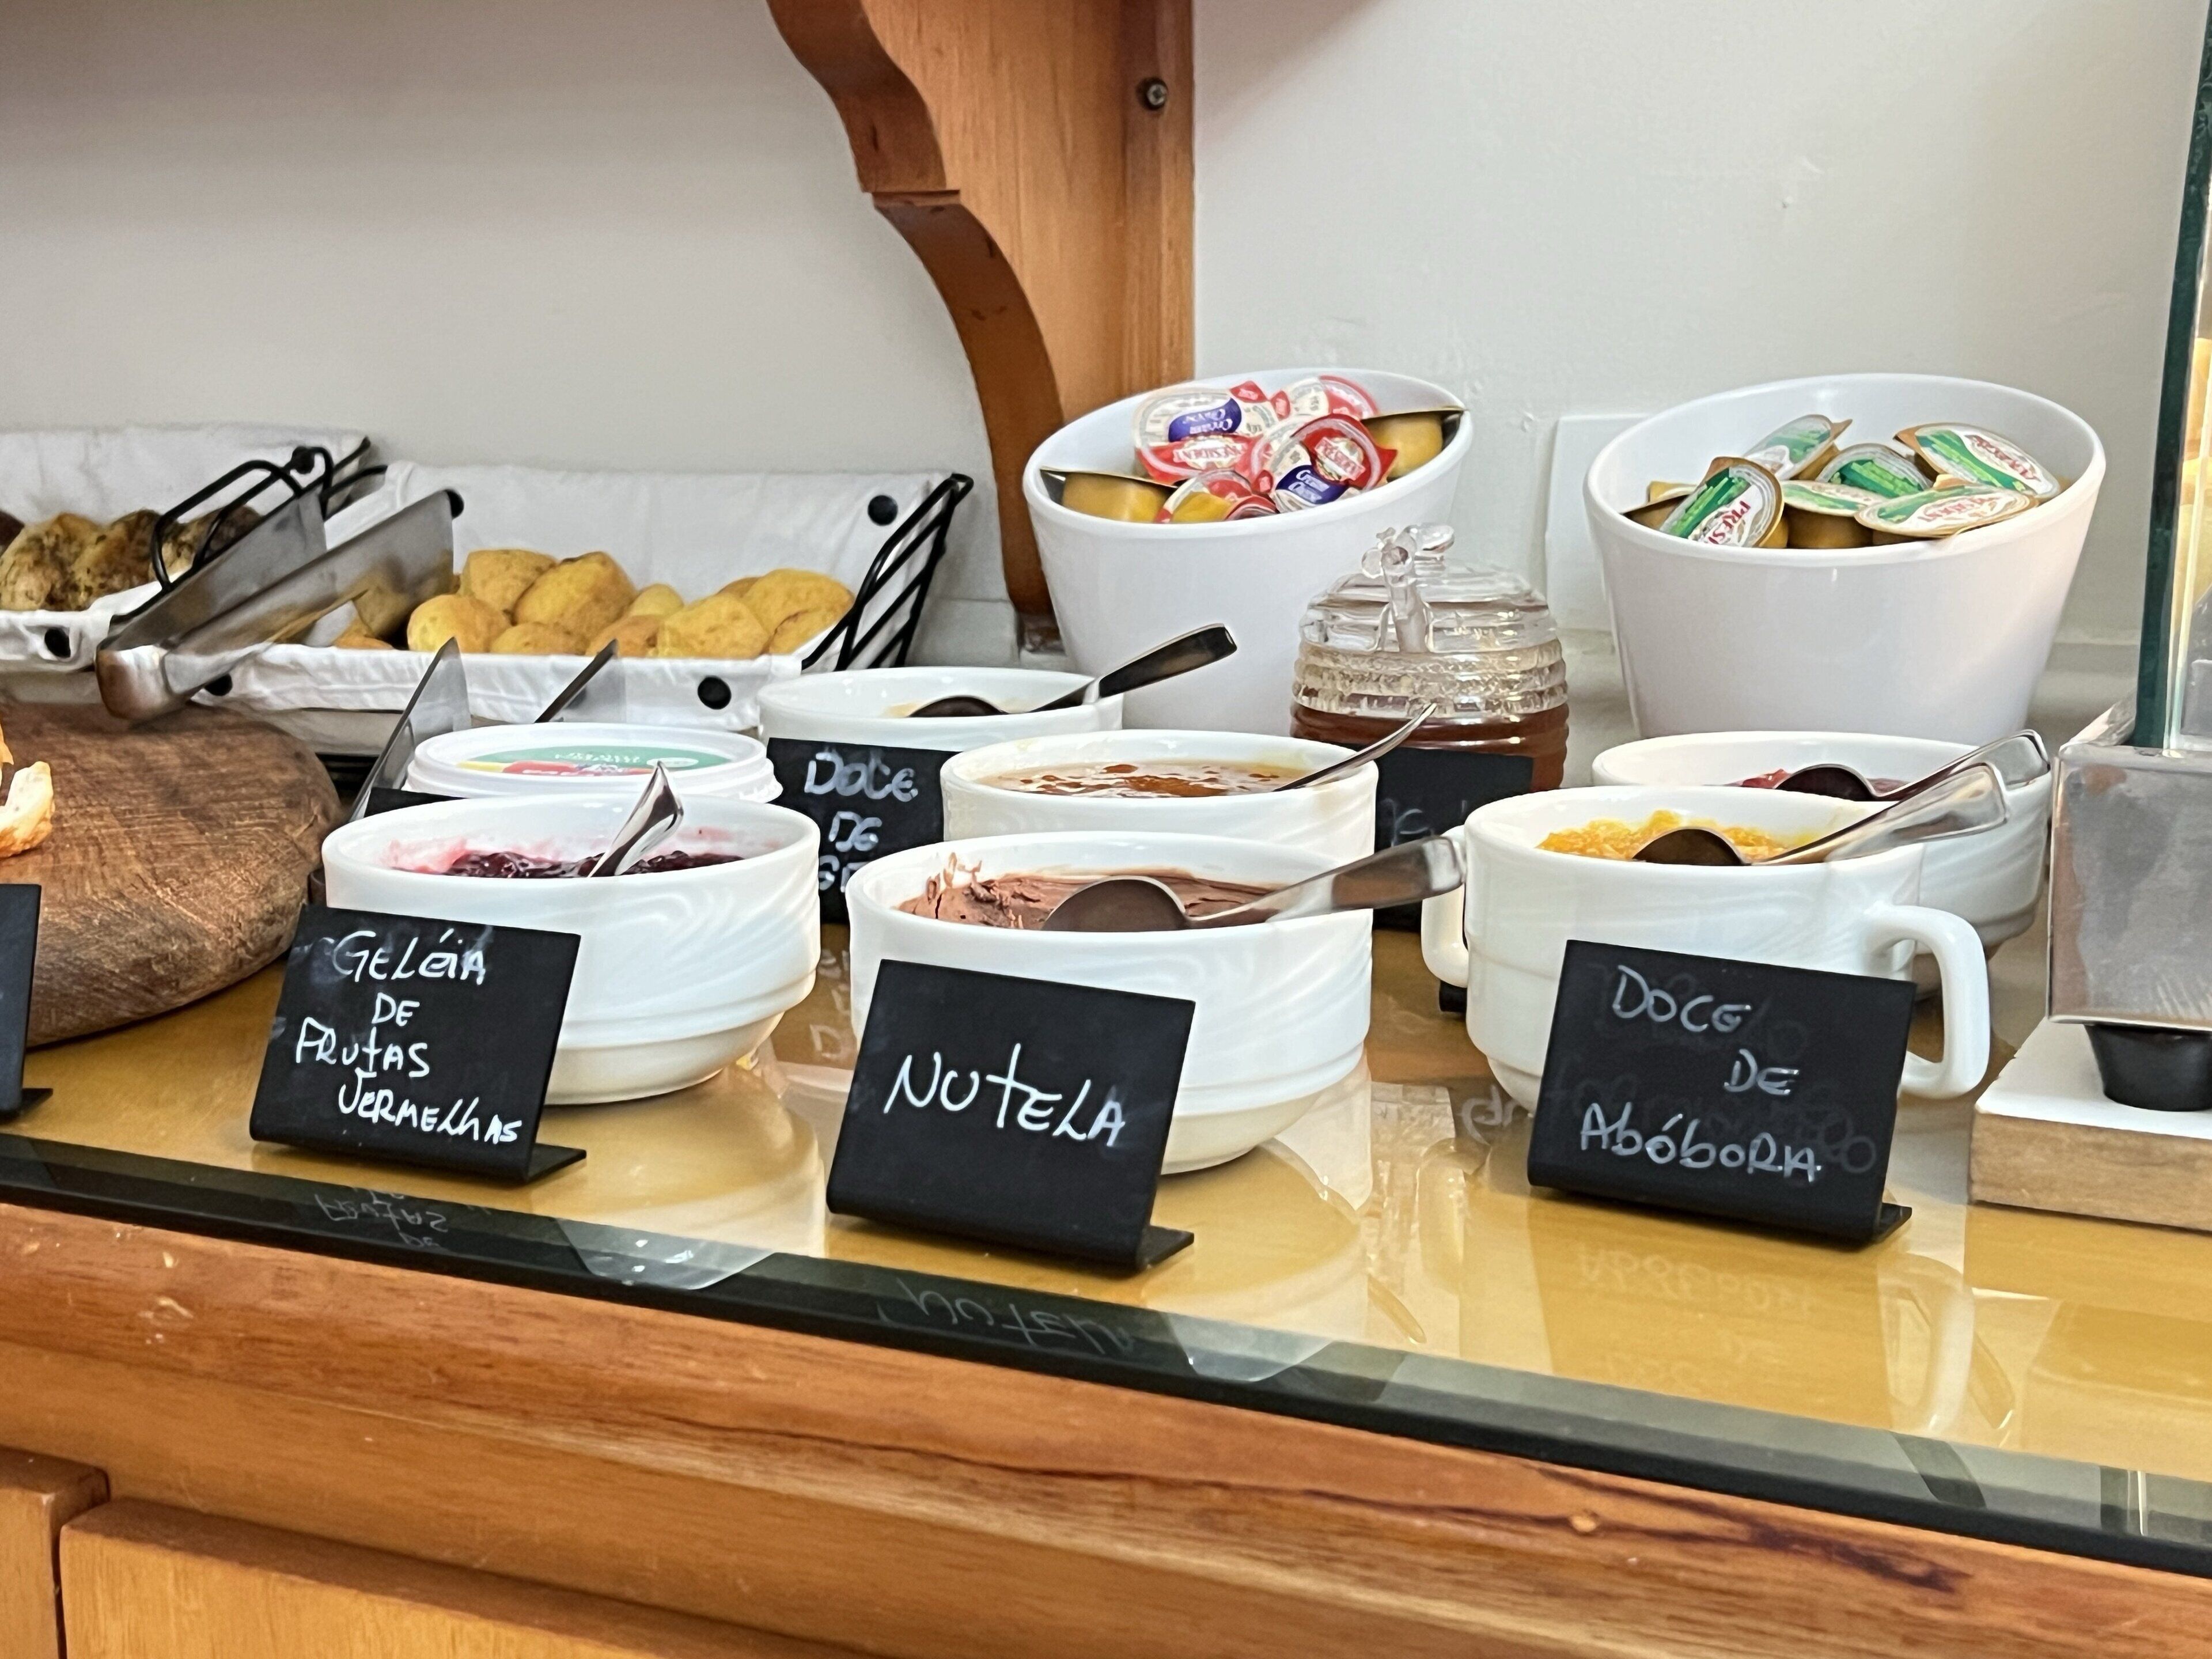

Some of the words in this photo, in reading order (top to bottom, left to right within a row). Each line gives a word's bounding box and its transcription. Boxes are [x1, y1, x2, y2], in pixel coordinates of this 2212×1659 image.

[372, 992, 419, 1027] DE
[1613, 964, 1752, 1032] DOCE
[1724, 1048, 1800, 1094] DE
